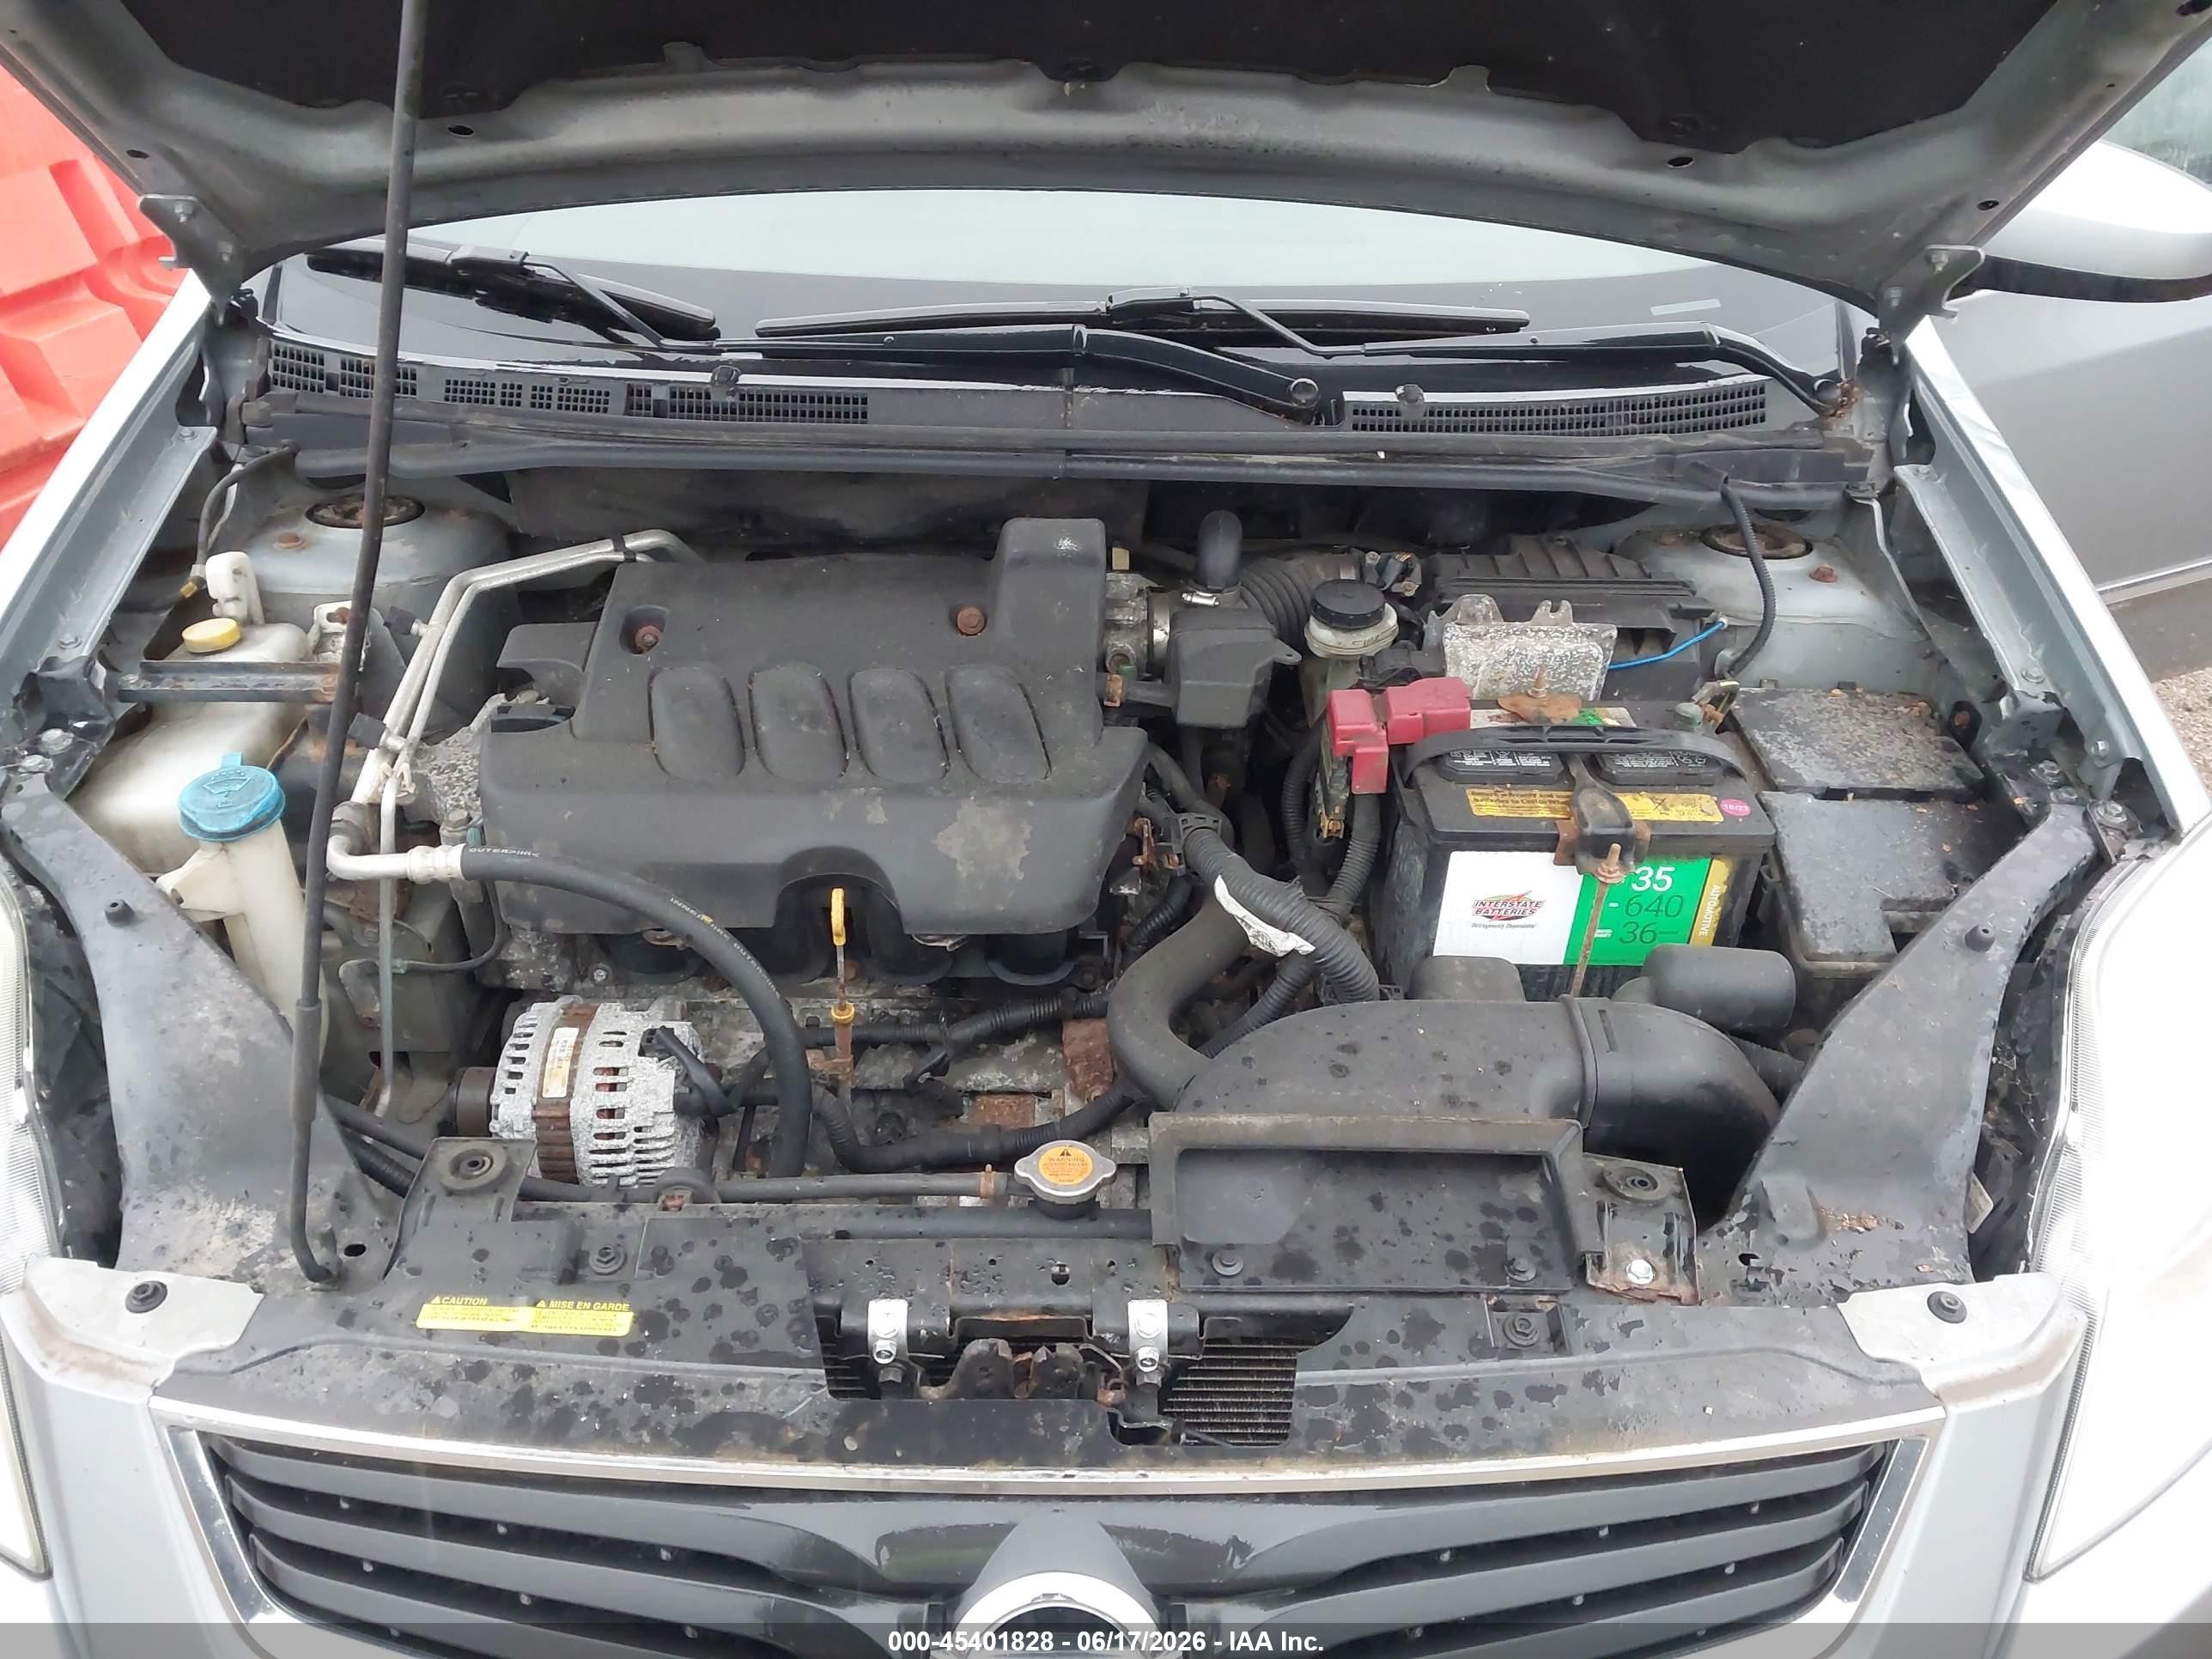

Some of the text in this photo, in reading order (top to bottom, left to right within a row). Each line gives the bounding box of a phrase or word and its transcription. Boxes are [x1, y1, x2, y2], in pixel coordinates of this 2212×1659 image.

[1632, 866, 1676, 892] 35
[1625, 894, 1684, 918] 640
[1698, 884, 1721, 937] AUTOMOTIVE
[441, 1296, 488, 1306] CAUTION
[549, 1299, 631, 1312] MISE EN GARDE
